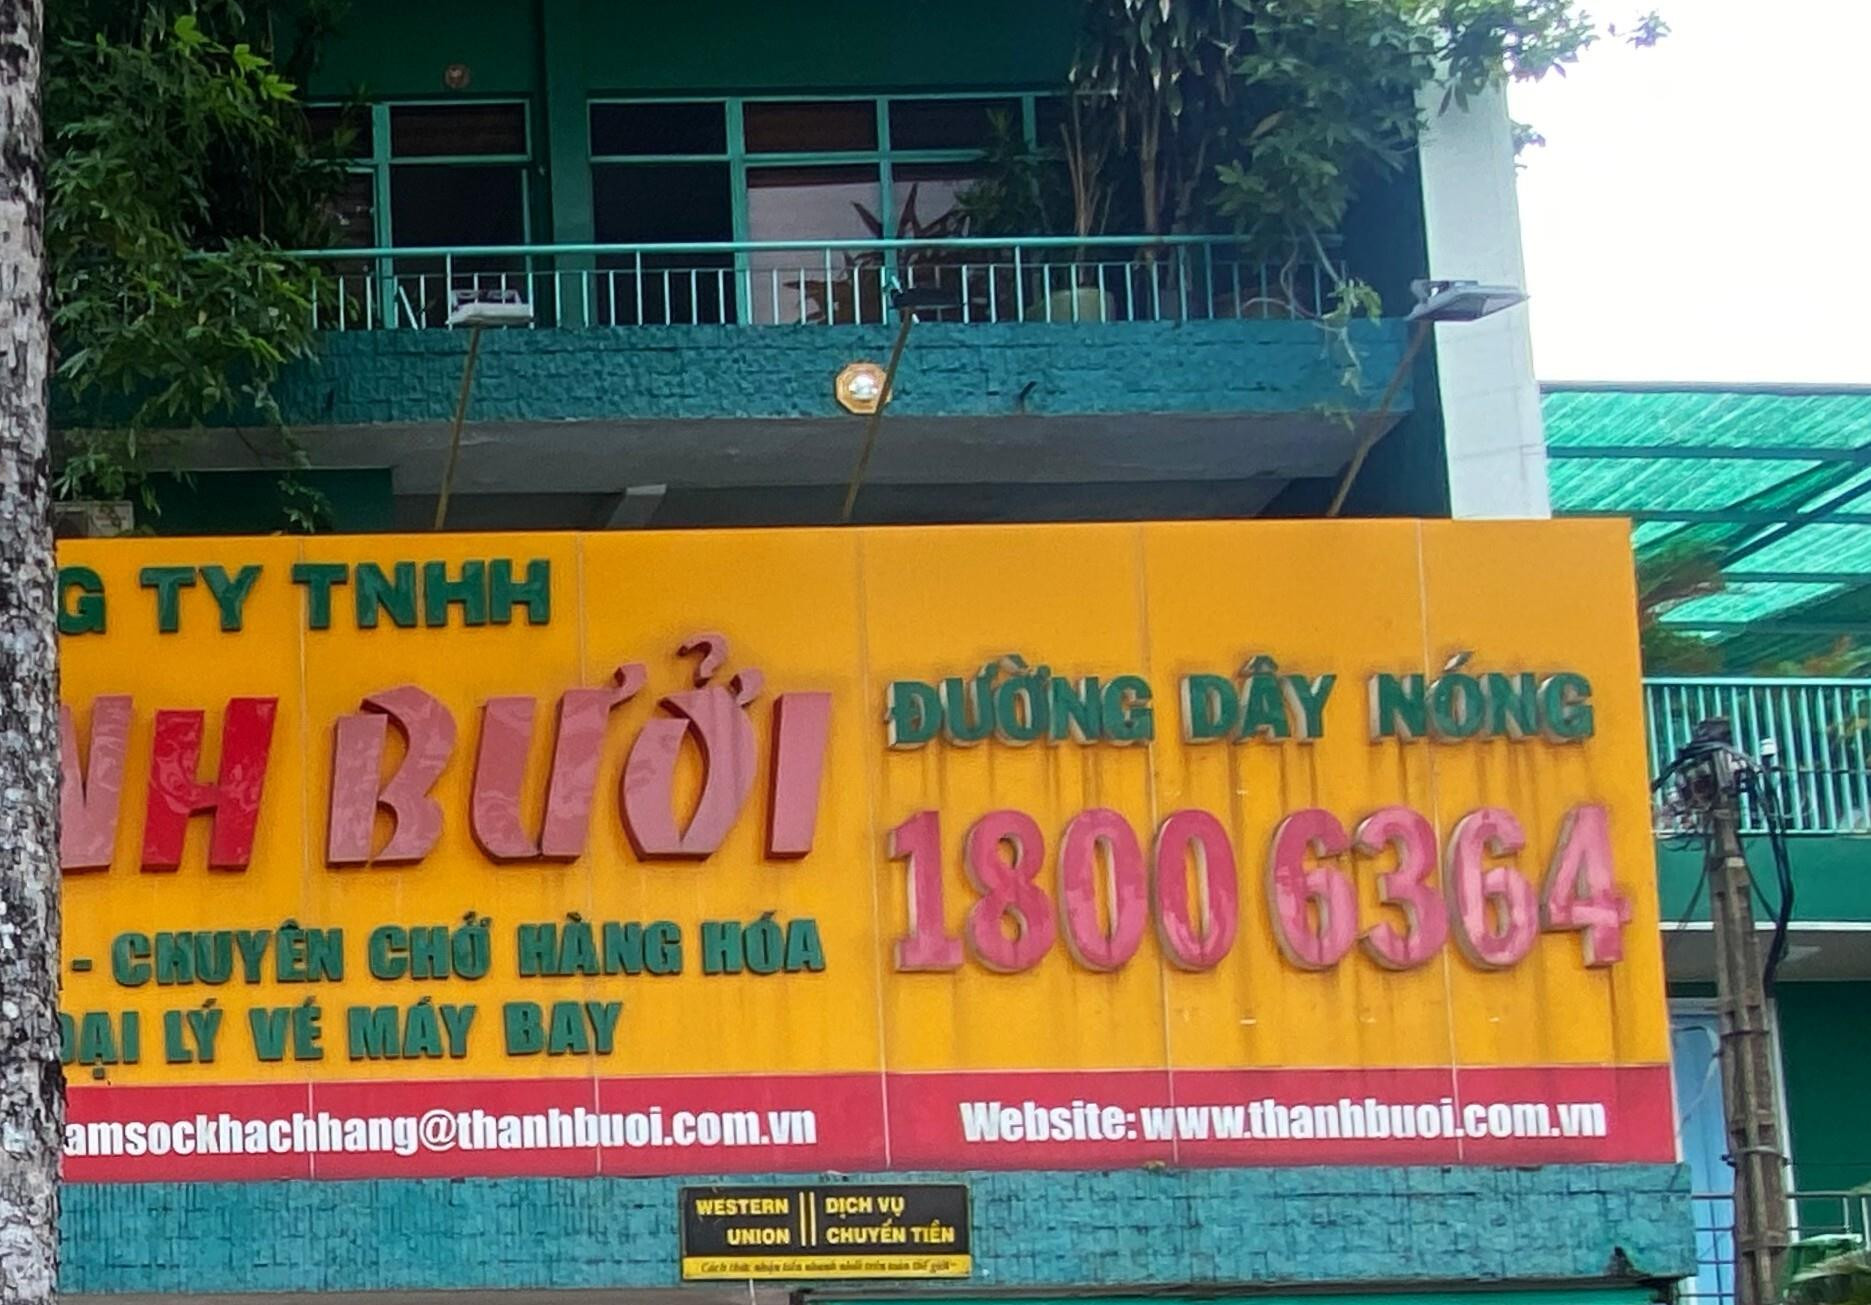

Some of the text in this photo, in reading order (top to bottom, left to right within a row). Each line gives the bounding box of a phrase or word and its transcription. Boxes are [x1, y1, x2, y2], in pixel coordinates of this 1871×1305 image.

[141, 564, 264, 634] TY
[292, 559, 551, 631] TNHH
[885, 650, 1596, 750] ĐƯỜNG DÂY NÓNG
[326, 633, 832, 870] BƯỞI
[887, 805, 1633, 973] 1800 6364
[111, 919, 343, 987] CHUYÊN
[368, 911, 493, 980] CHỞ
[518, 911, 683, 977] HÀNG
[701, 910, 826, 975] HÓA
[164, 998, 222, 1063] LÝ
[249, 996, 324, 1061] VÉ
[347, 995, 477, 1060] MÁY
[503, 1000, 623, 1058] BAY
[959, 1097, 1606, 1143] Website: www.thanhbuoi.com.vn
[696, 1198, 789, 1216] WESTERN
[727, 1227, 790, 1246] UNION
[825, 1197, 904, 1219] DỊCH VỤ
[910, 1219, 956, 1243] TIỀN
